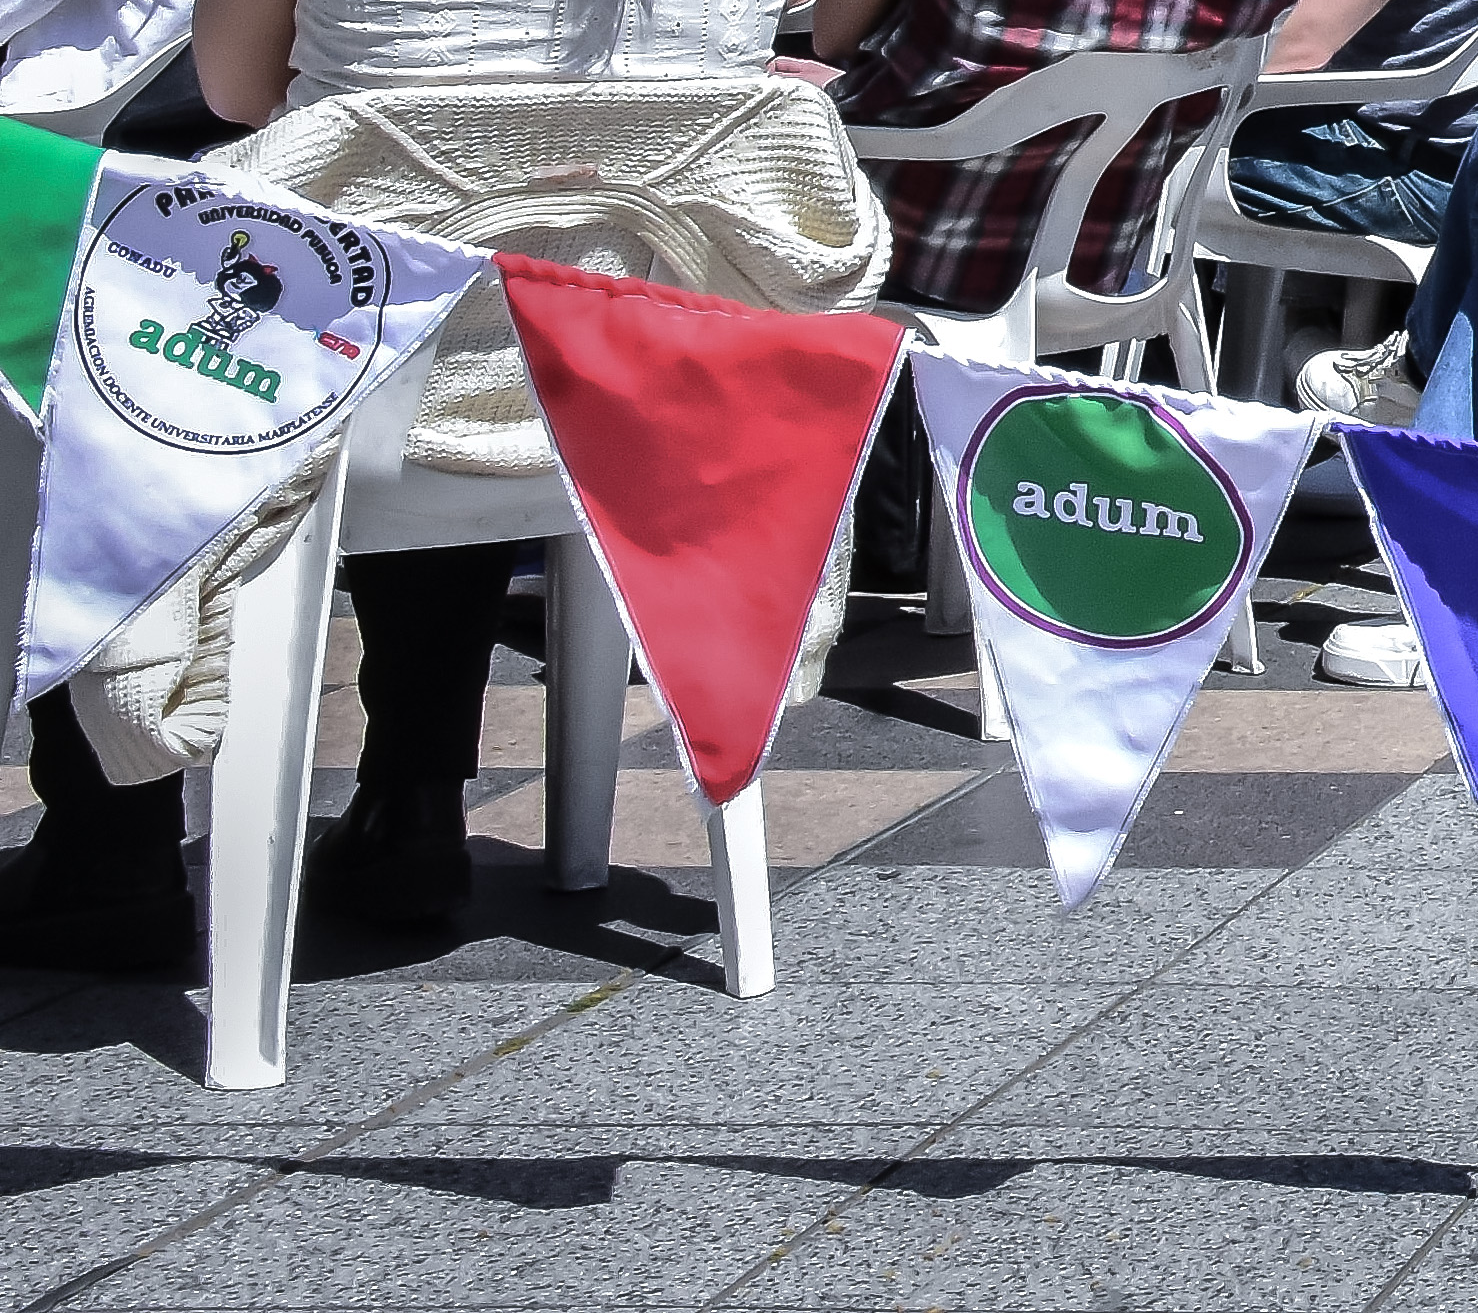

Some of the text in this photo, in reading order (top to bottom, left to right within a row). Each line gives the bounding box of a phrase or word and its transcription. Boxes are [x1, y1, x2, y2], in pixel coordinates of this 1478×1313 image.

[128, 318, 281, 404] adum
[103, 373, 153, 422] DOCENTE
[150, 416, 256, 446] UNIVERSITARIA
[257, 391, 339, 442] MARPLATENSE
[1012, 480, 1205, 543] adum
